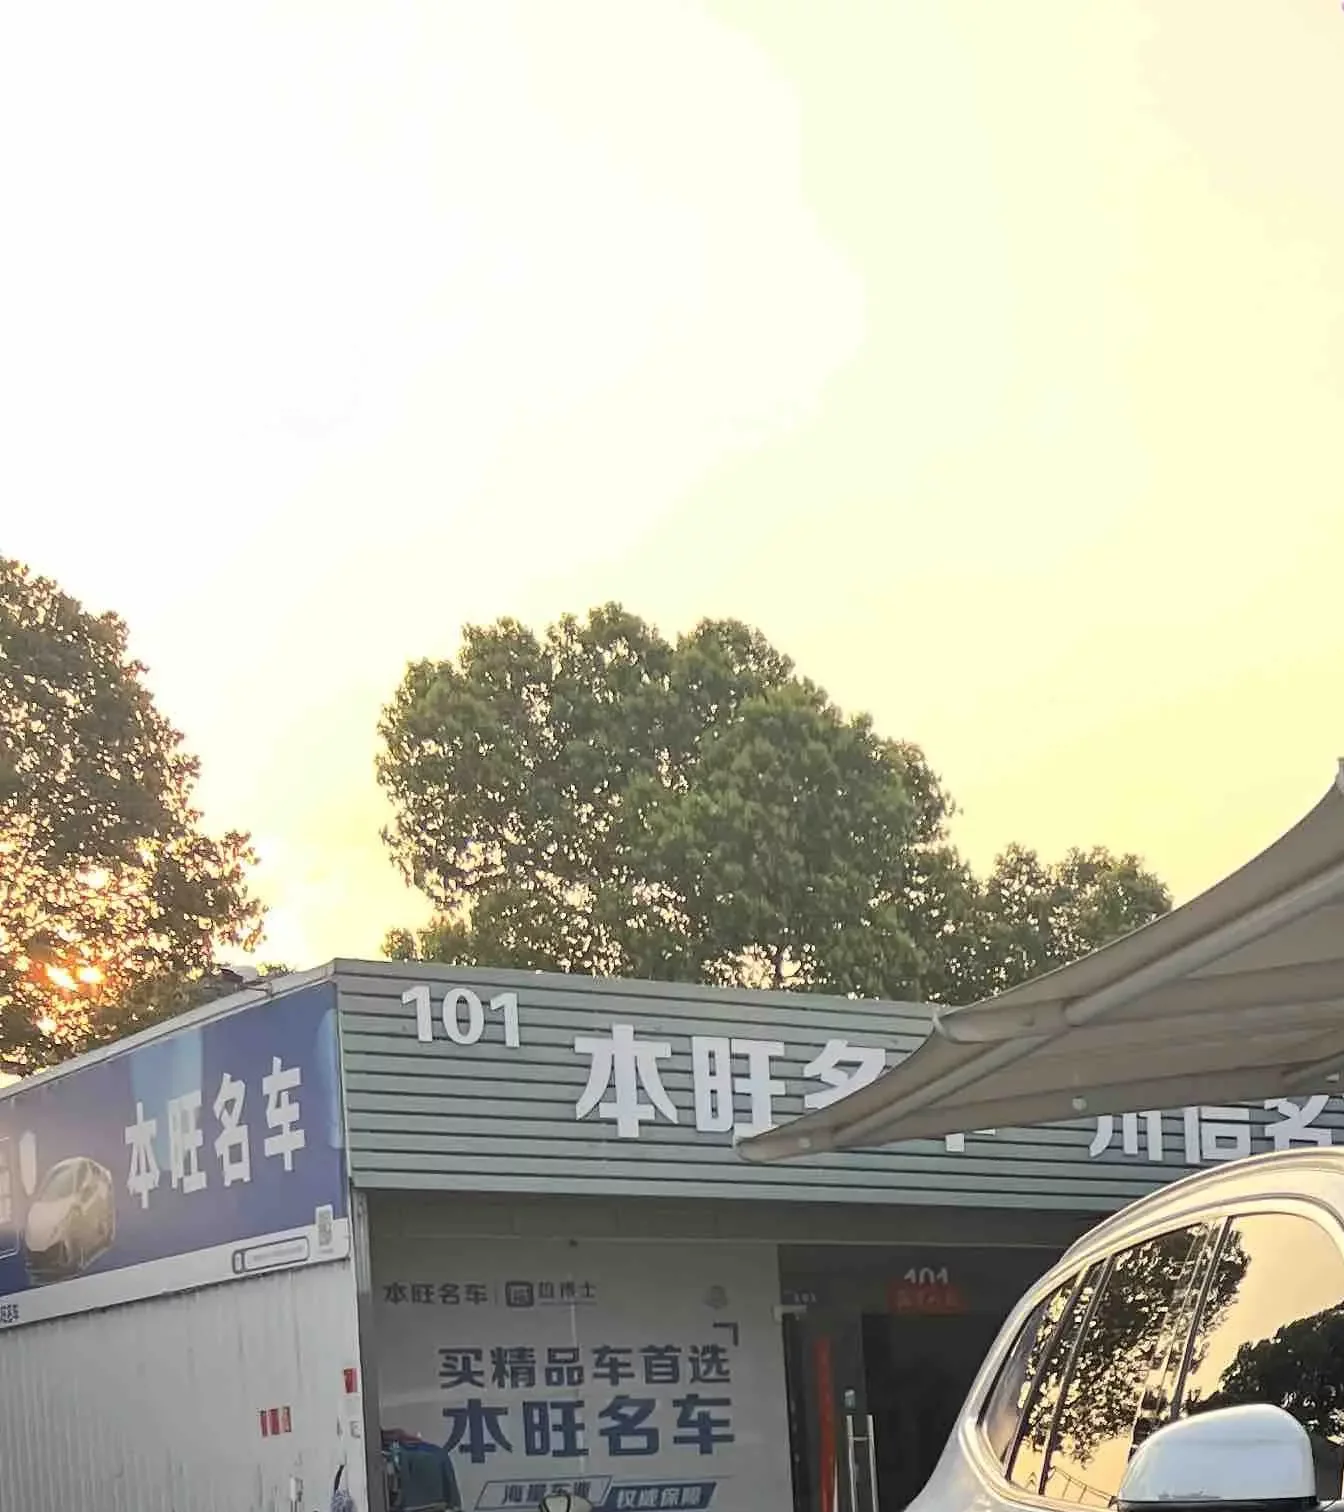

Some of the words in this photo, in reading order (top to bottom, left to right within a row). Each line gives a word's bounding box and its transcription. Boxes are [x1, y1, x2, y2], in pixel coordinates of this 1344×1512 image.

[402, 985, 520, 1048] 101
[125, 1056, 306, 1209] 本旺名车
[438, 1344, 732, 1389] 买精品车首选
[442, 1394, 736, 1464] 本旺名车
